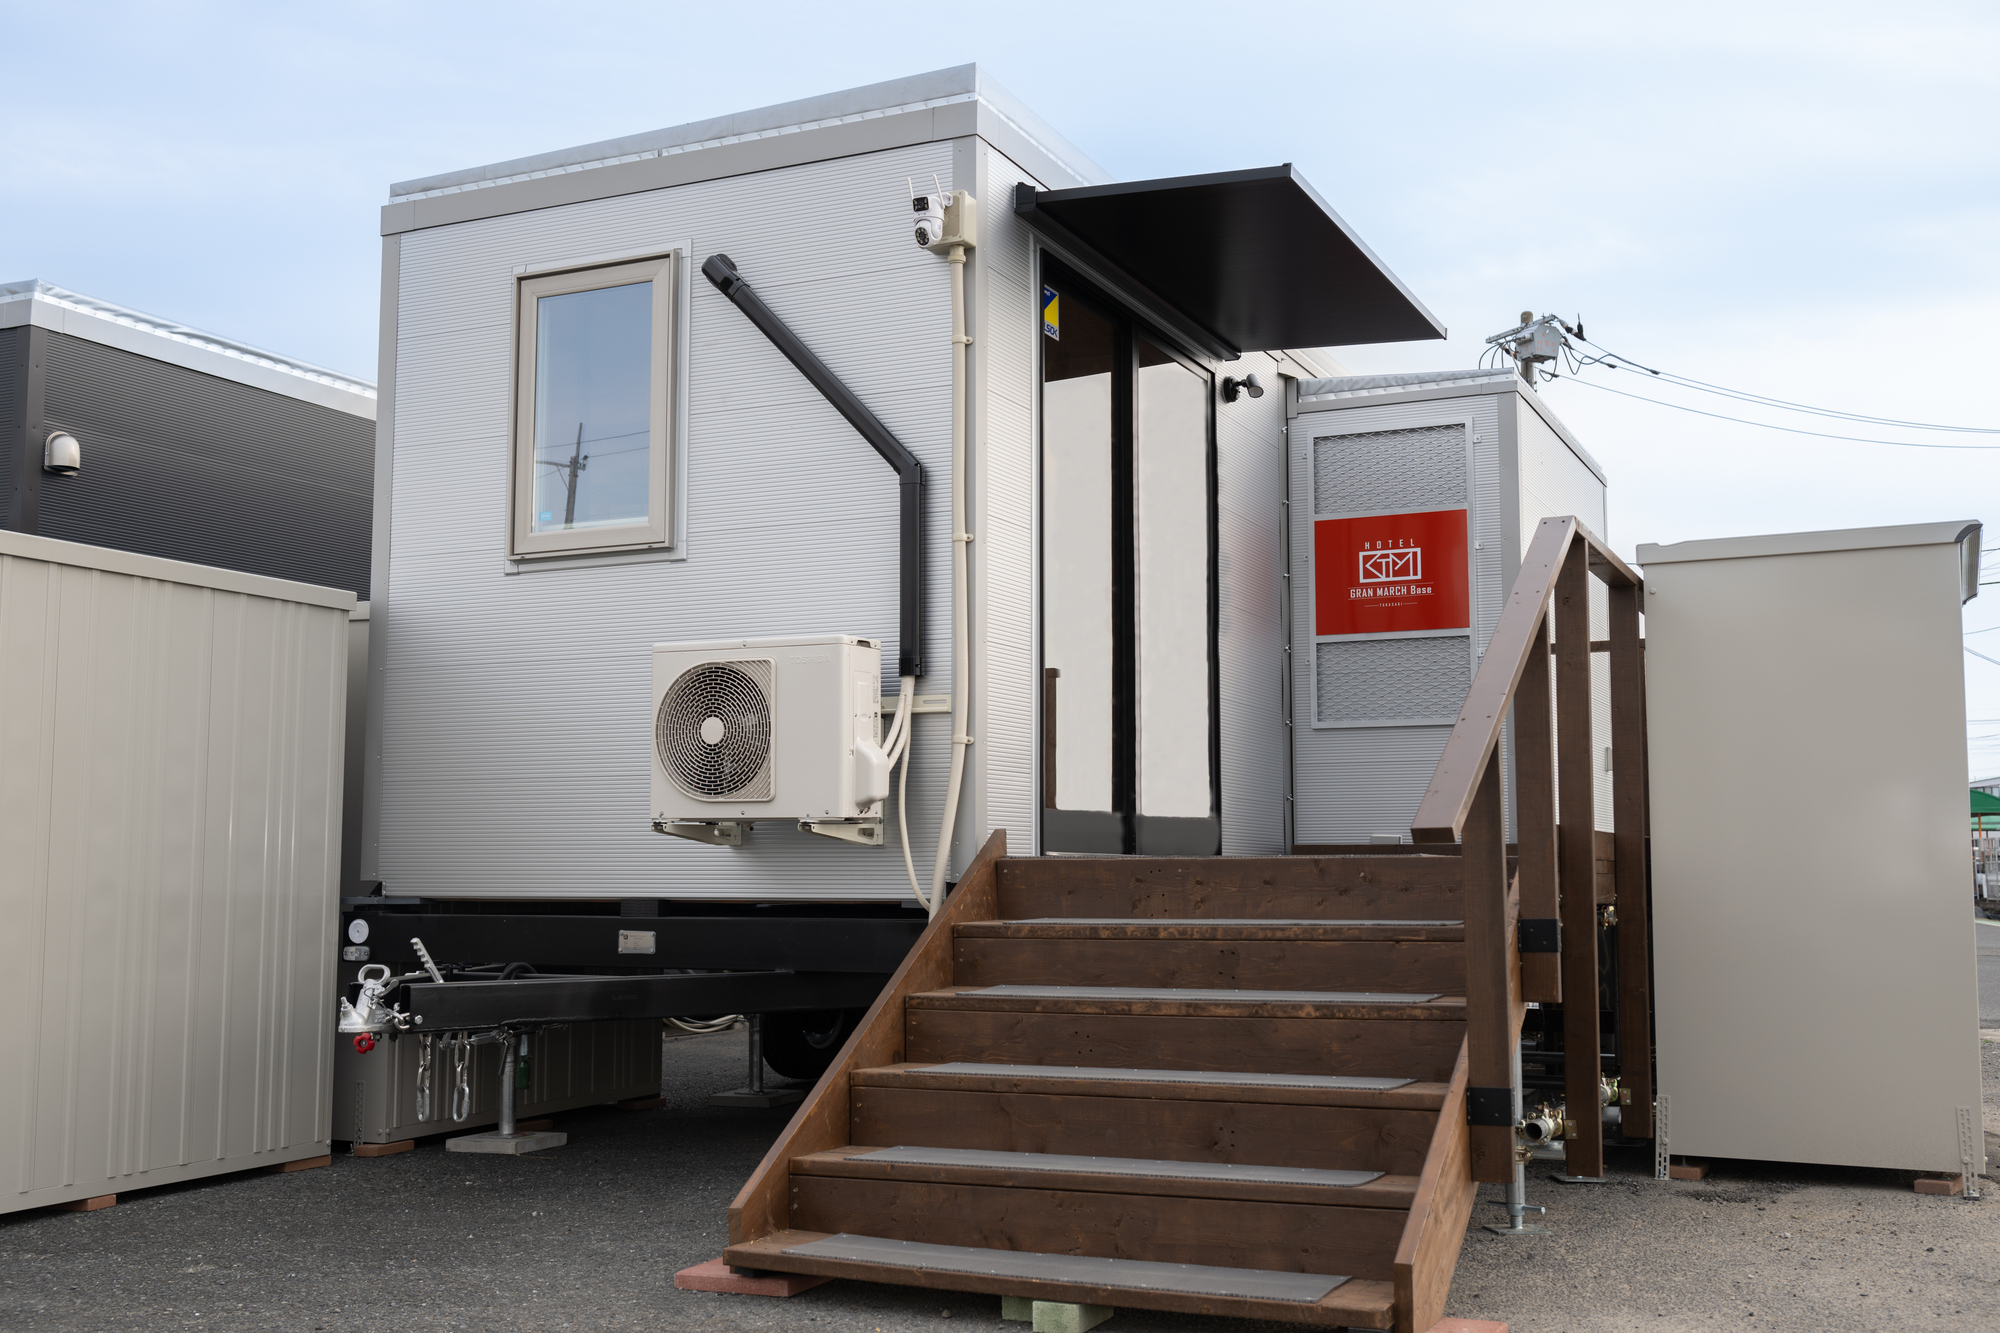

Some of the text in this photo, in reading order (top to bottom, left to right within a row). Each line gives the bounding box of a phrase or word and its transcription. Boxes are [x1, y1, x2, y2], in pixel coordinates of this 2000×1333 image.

[1364, 538, 1415, 550] HOTEL
[1350, 585, 1432, 599] GRAN MARCH Base
[788, 653, 831, 665] TOSHIBA
